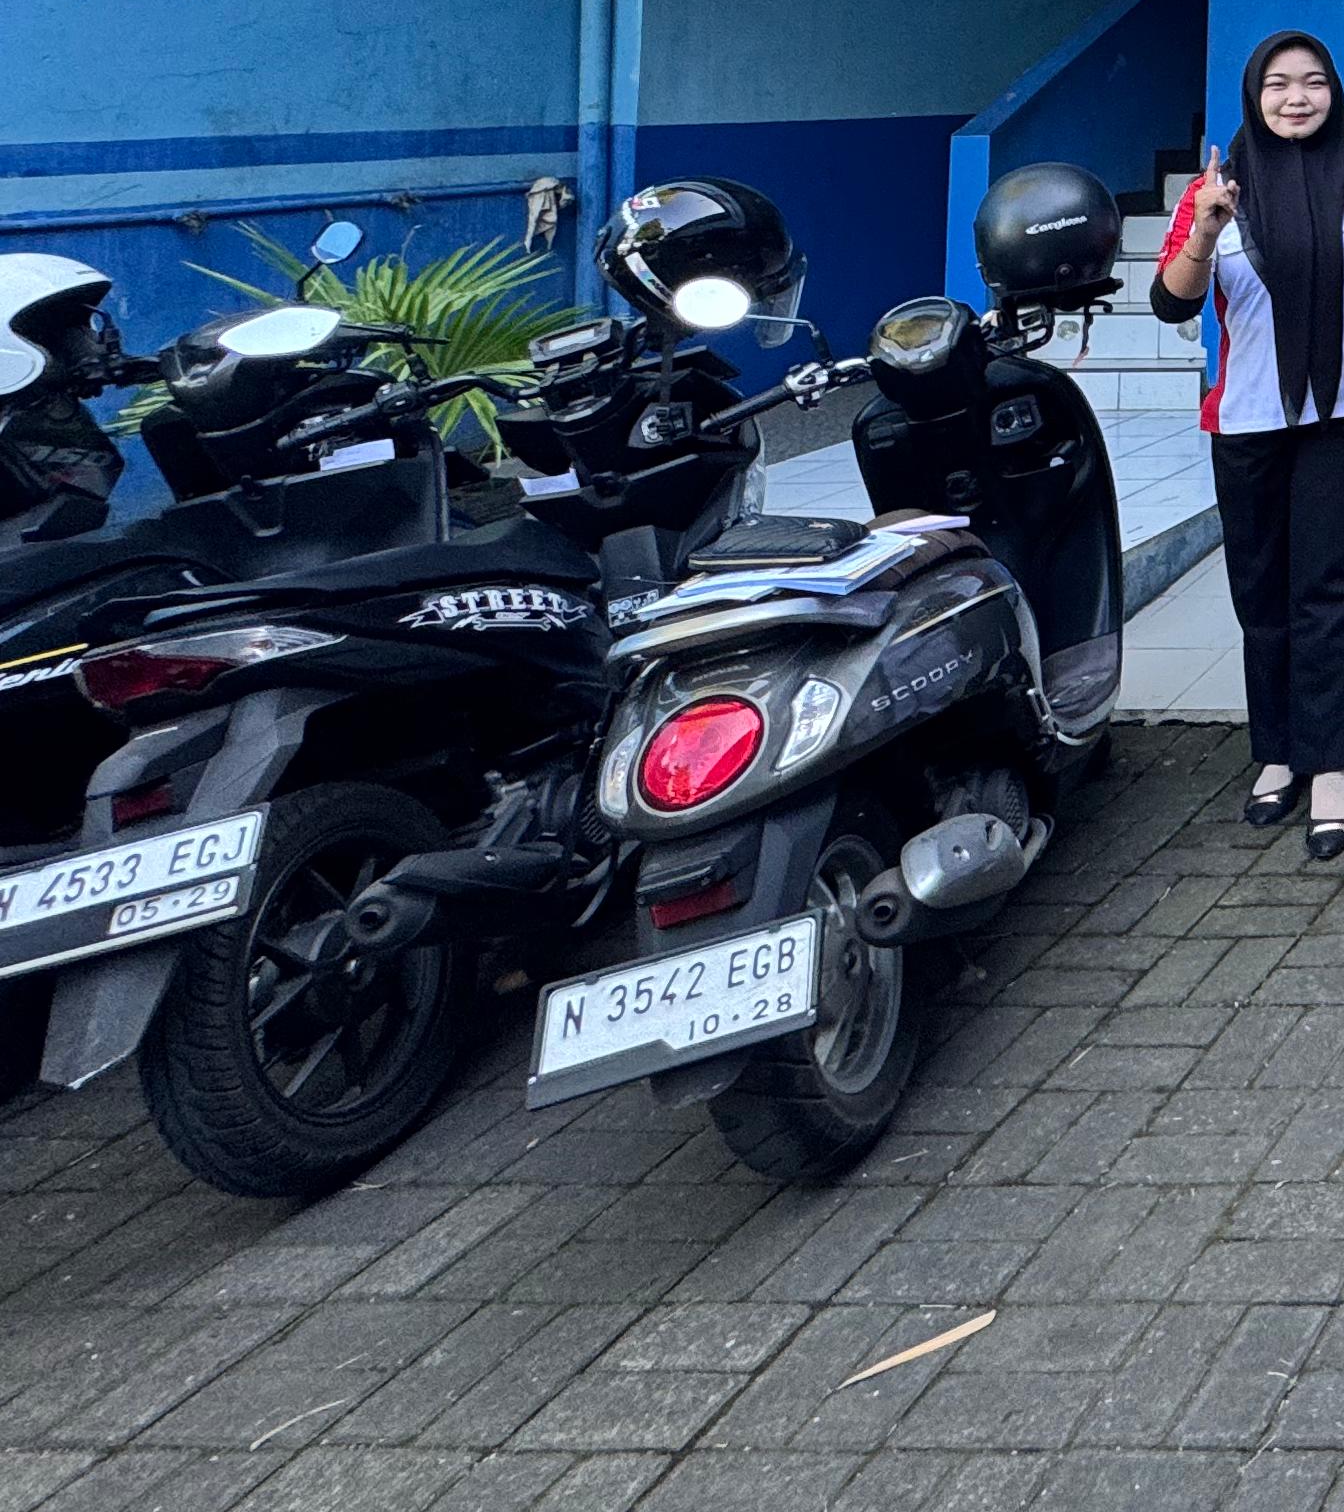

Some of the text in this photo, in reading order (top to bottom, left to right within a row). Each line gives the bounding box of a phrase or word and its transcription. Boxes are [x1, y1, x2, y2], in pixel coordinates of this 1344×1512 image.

[439, 589, 563, 618] STREET
[871, 650, 974, 712] SCOOPY
[37, 853, 142, 910] 4533
[168, 826, 248, 875] EGJ
[562, 938, 796, 1039] N 3542 EGB
